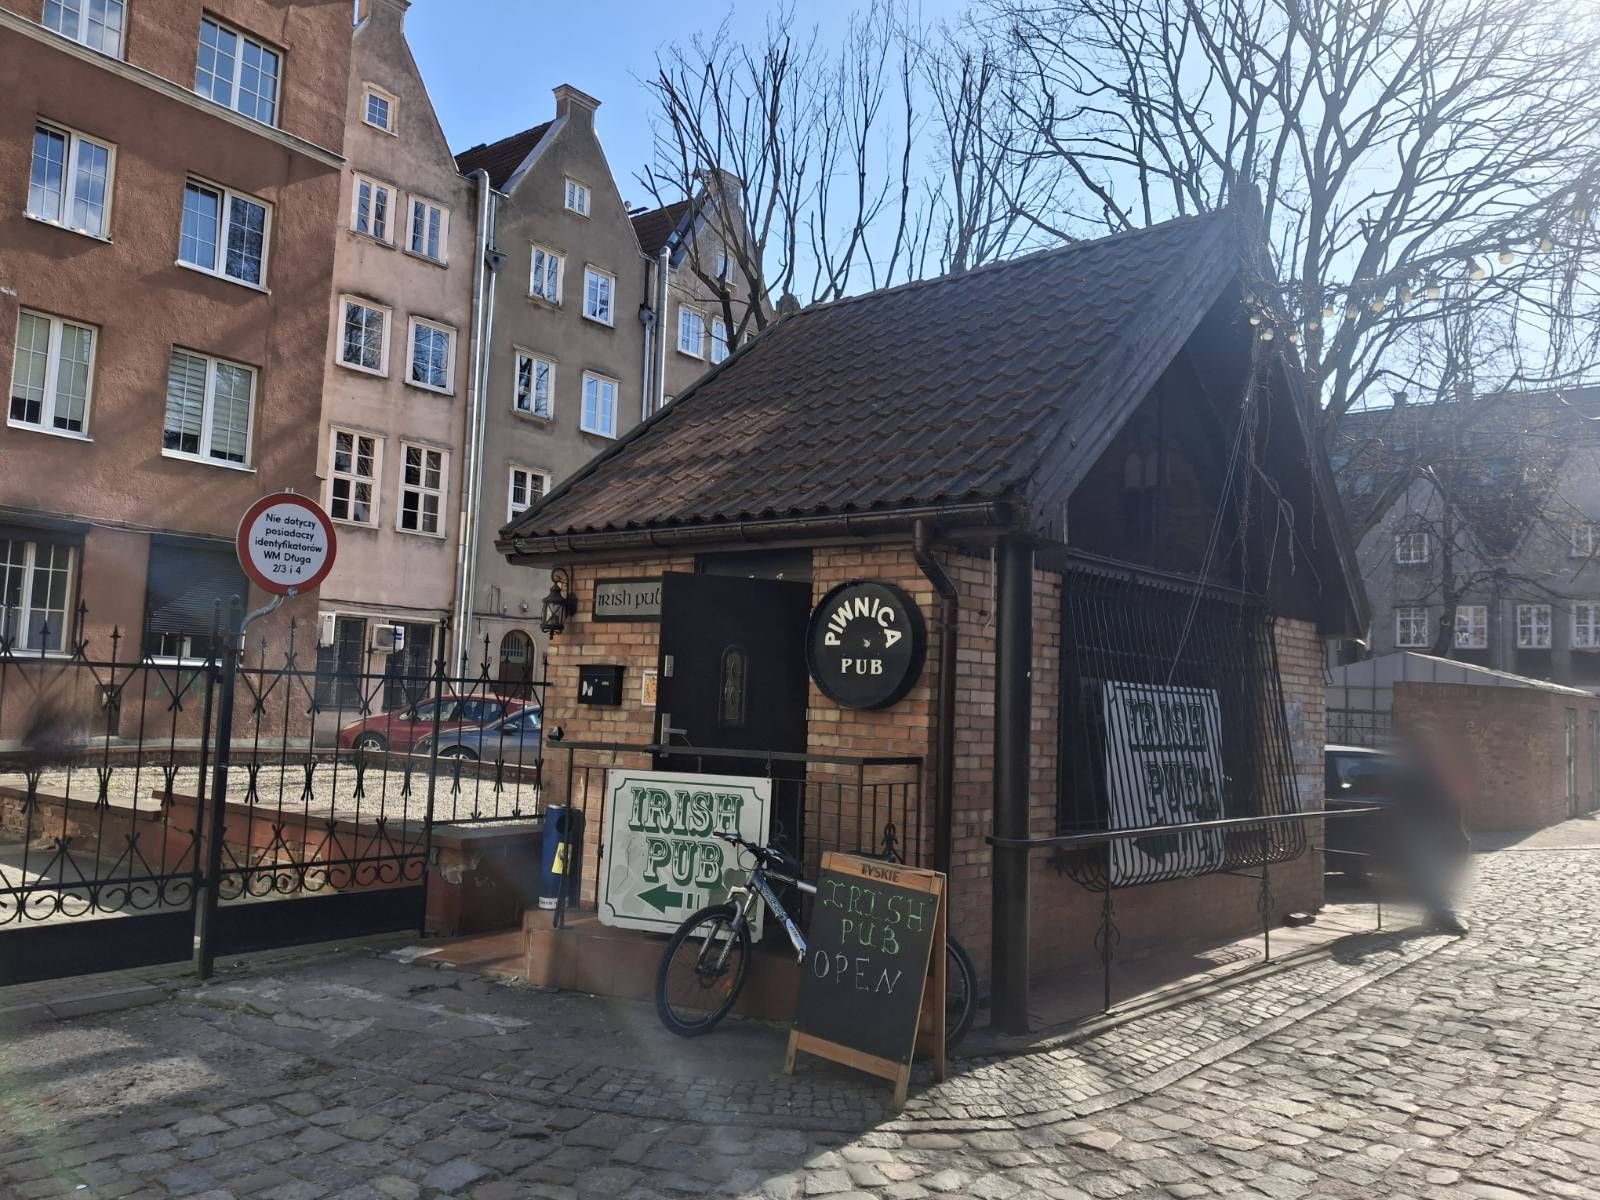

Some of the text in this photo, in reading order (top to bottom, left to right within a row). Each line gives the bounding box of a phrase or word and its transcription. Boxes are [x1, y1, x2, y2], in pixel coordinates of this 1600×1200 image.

[265, 513, 316, 530] Nie dotyczy
[265, 527, 315, 542] posiadaczy
[255, 537, 323, 553] identyfikatorów
[263, 550, 312, 565] WM Długa
[272, 564, 302, 575] 2/3 i 4
[824, 596, 902, 649] PIWNICA
[841, 658, 883, 675] PUB
[1125, 698, 1208, 754] IRISH
[628, 786, 744, 838] IRISH
[643, 836, 724, 890] PUB
[861, 863, 901, 883] TYSKIE
[823, 879, 925, 932] IRISH
[841, 918, 900, 955] PUB
[814, 950, 903, 994] OPEN
